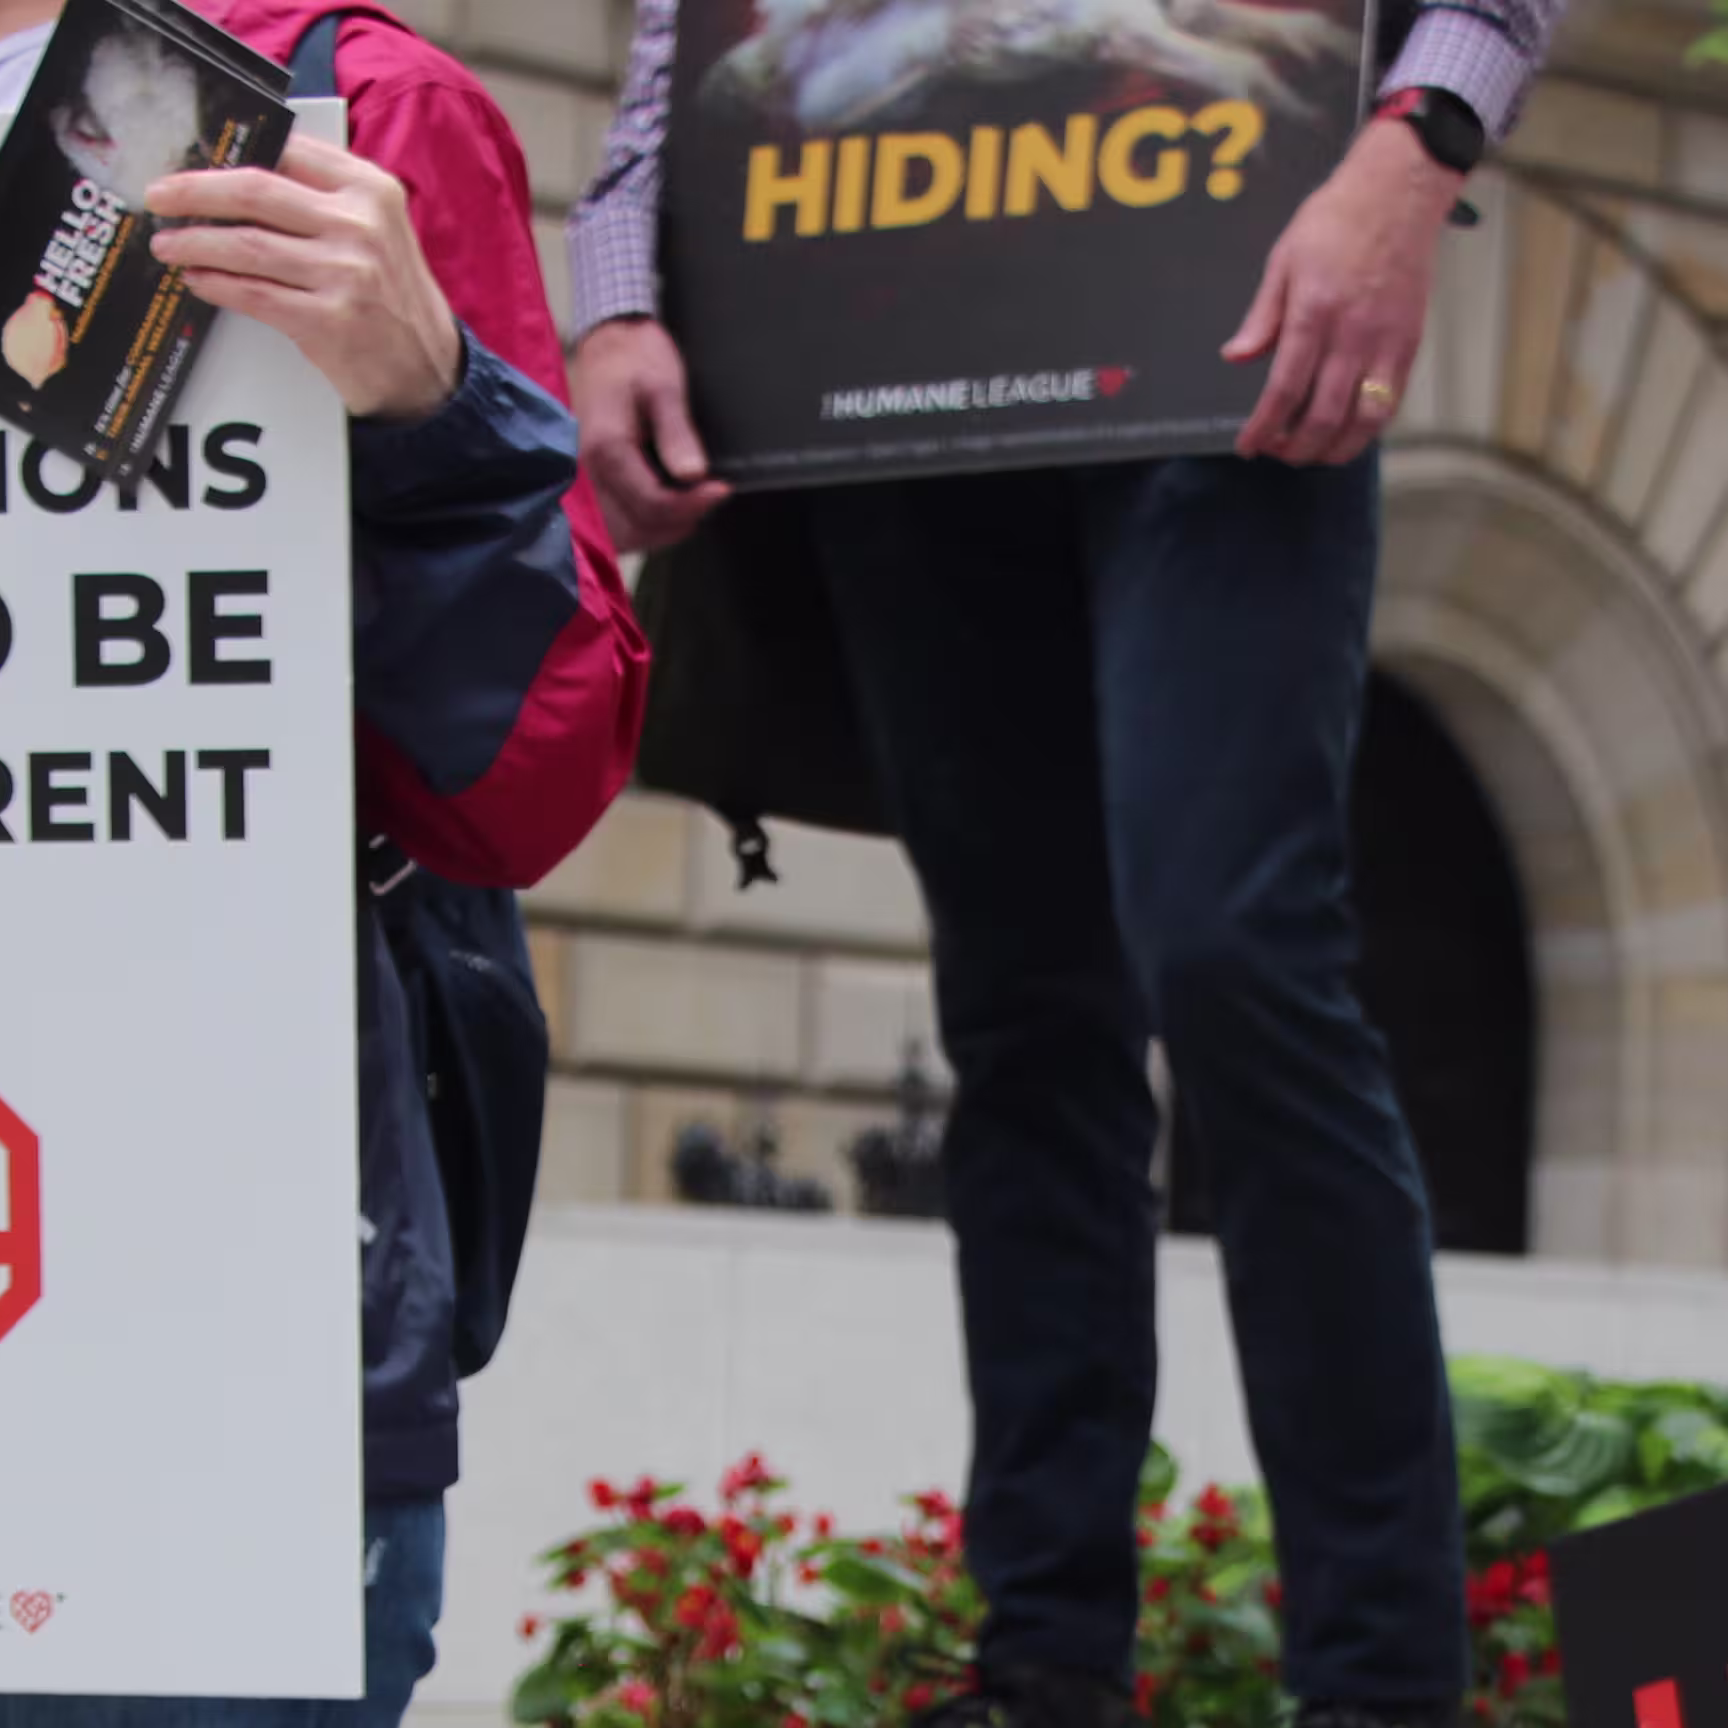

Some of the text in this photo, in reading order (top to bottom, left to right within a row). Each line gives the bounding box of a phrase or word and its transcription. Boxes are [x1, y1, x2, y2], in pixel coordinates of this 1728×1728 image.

[743, 100, 1263, 241] HIDING?
[33, 178, 99, 292] HELLO
[57, 190, 127, 307] FRESH
[833, 378, 969, 418] HUMANE
[971, 369, 1093, 408] LEAGUE
[73, 569, 272, 687] BE
